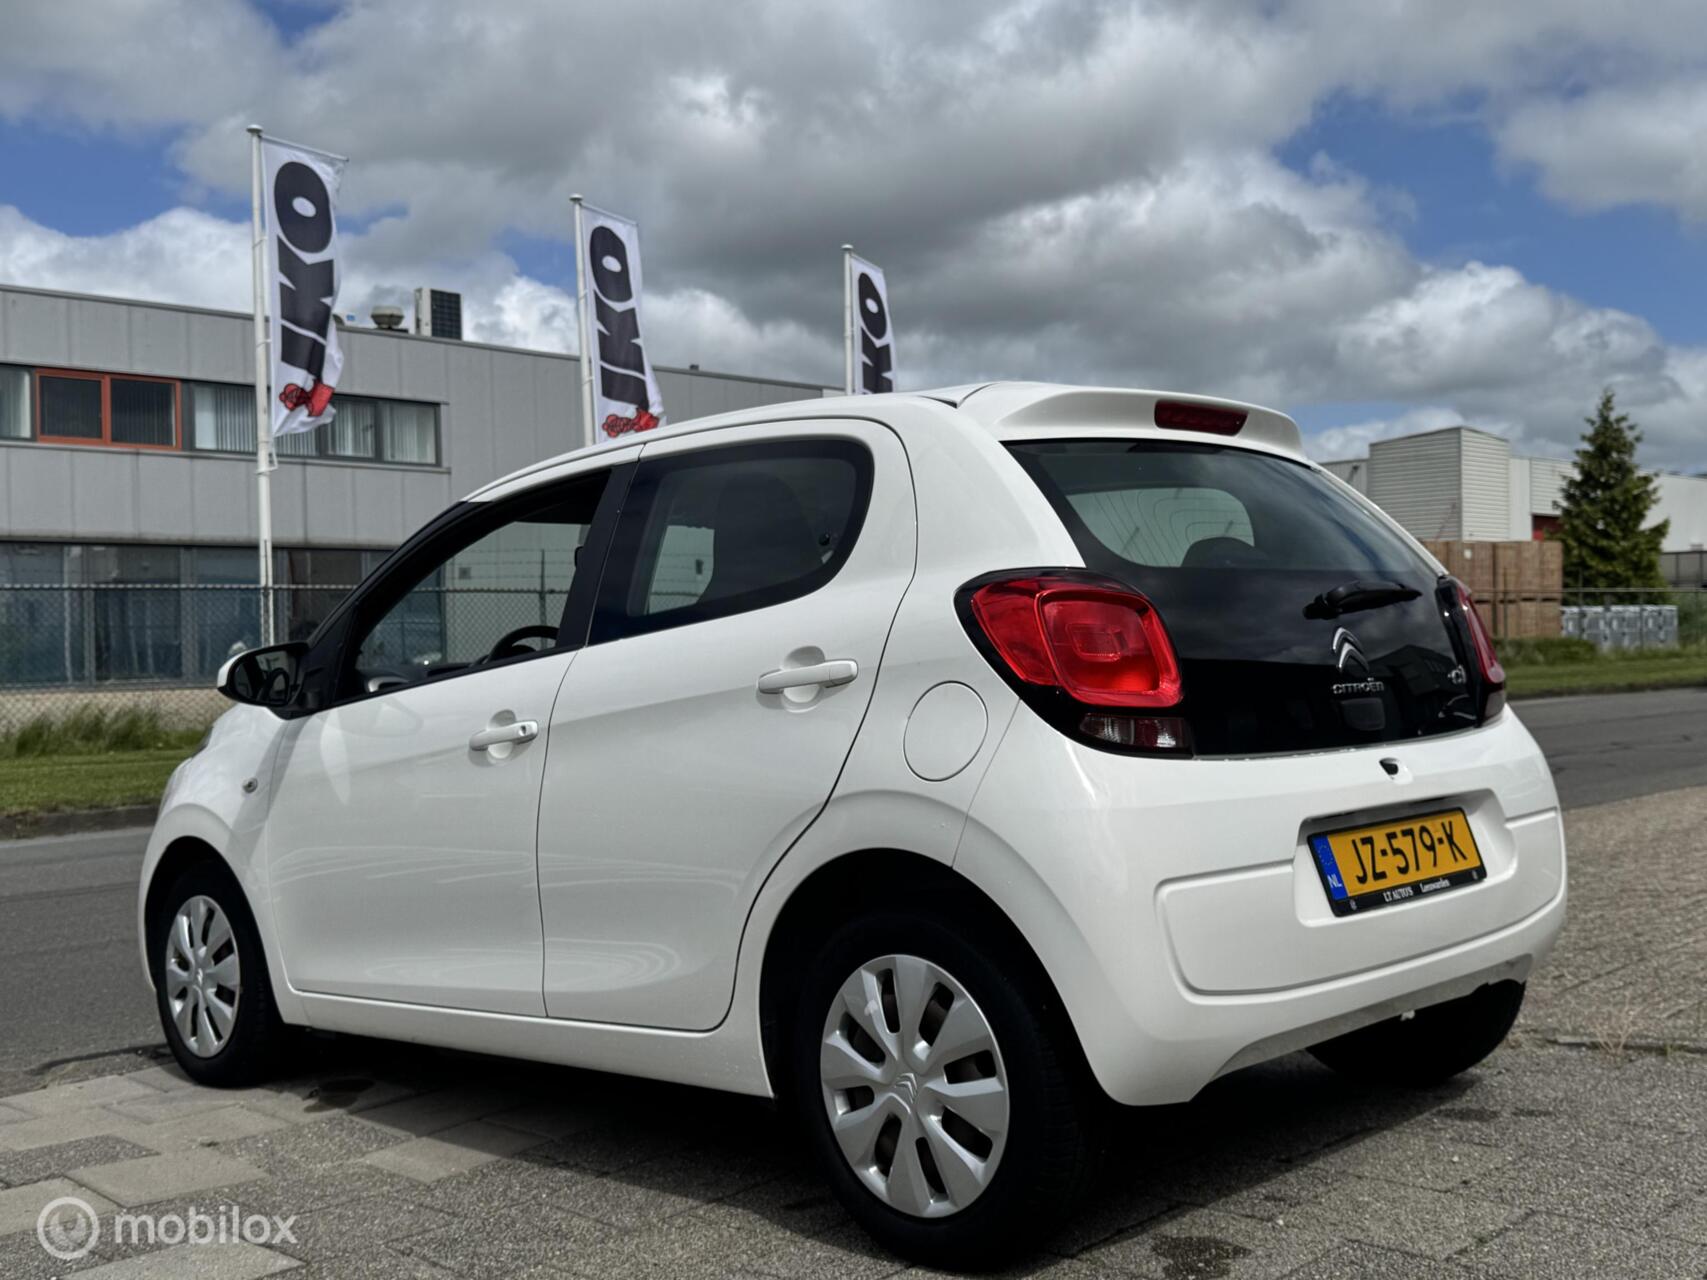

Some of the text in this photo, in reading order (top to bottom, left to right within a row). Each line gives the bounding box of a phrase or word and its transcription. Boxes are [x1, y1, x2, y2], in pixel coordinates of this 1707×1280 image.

[274, 161, 334, 381] IKO
[590, 226, 649, 411] IKO
[858, 272, 893, 394] KO
[1327, 874, 1342, 888] NL
[1352, 820, 1467, 884] JZ-579-K
